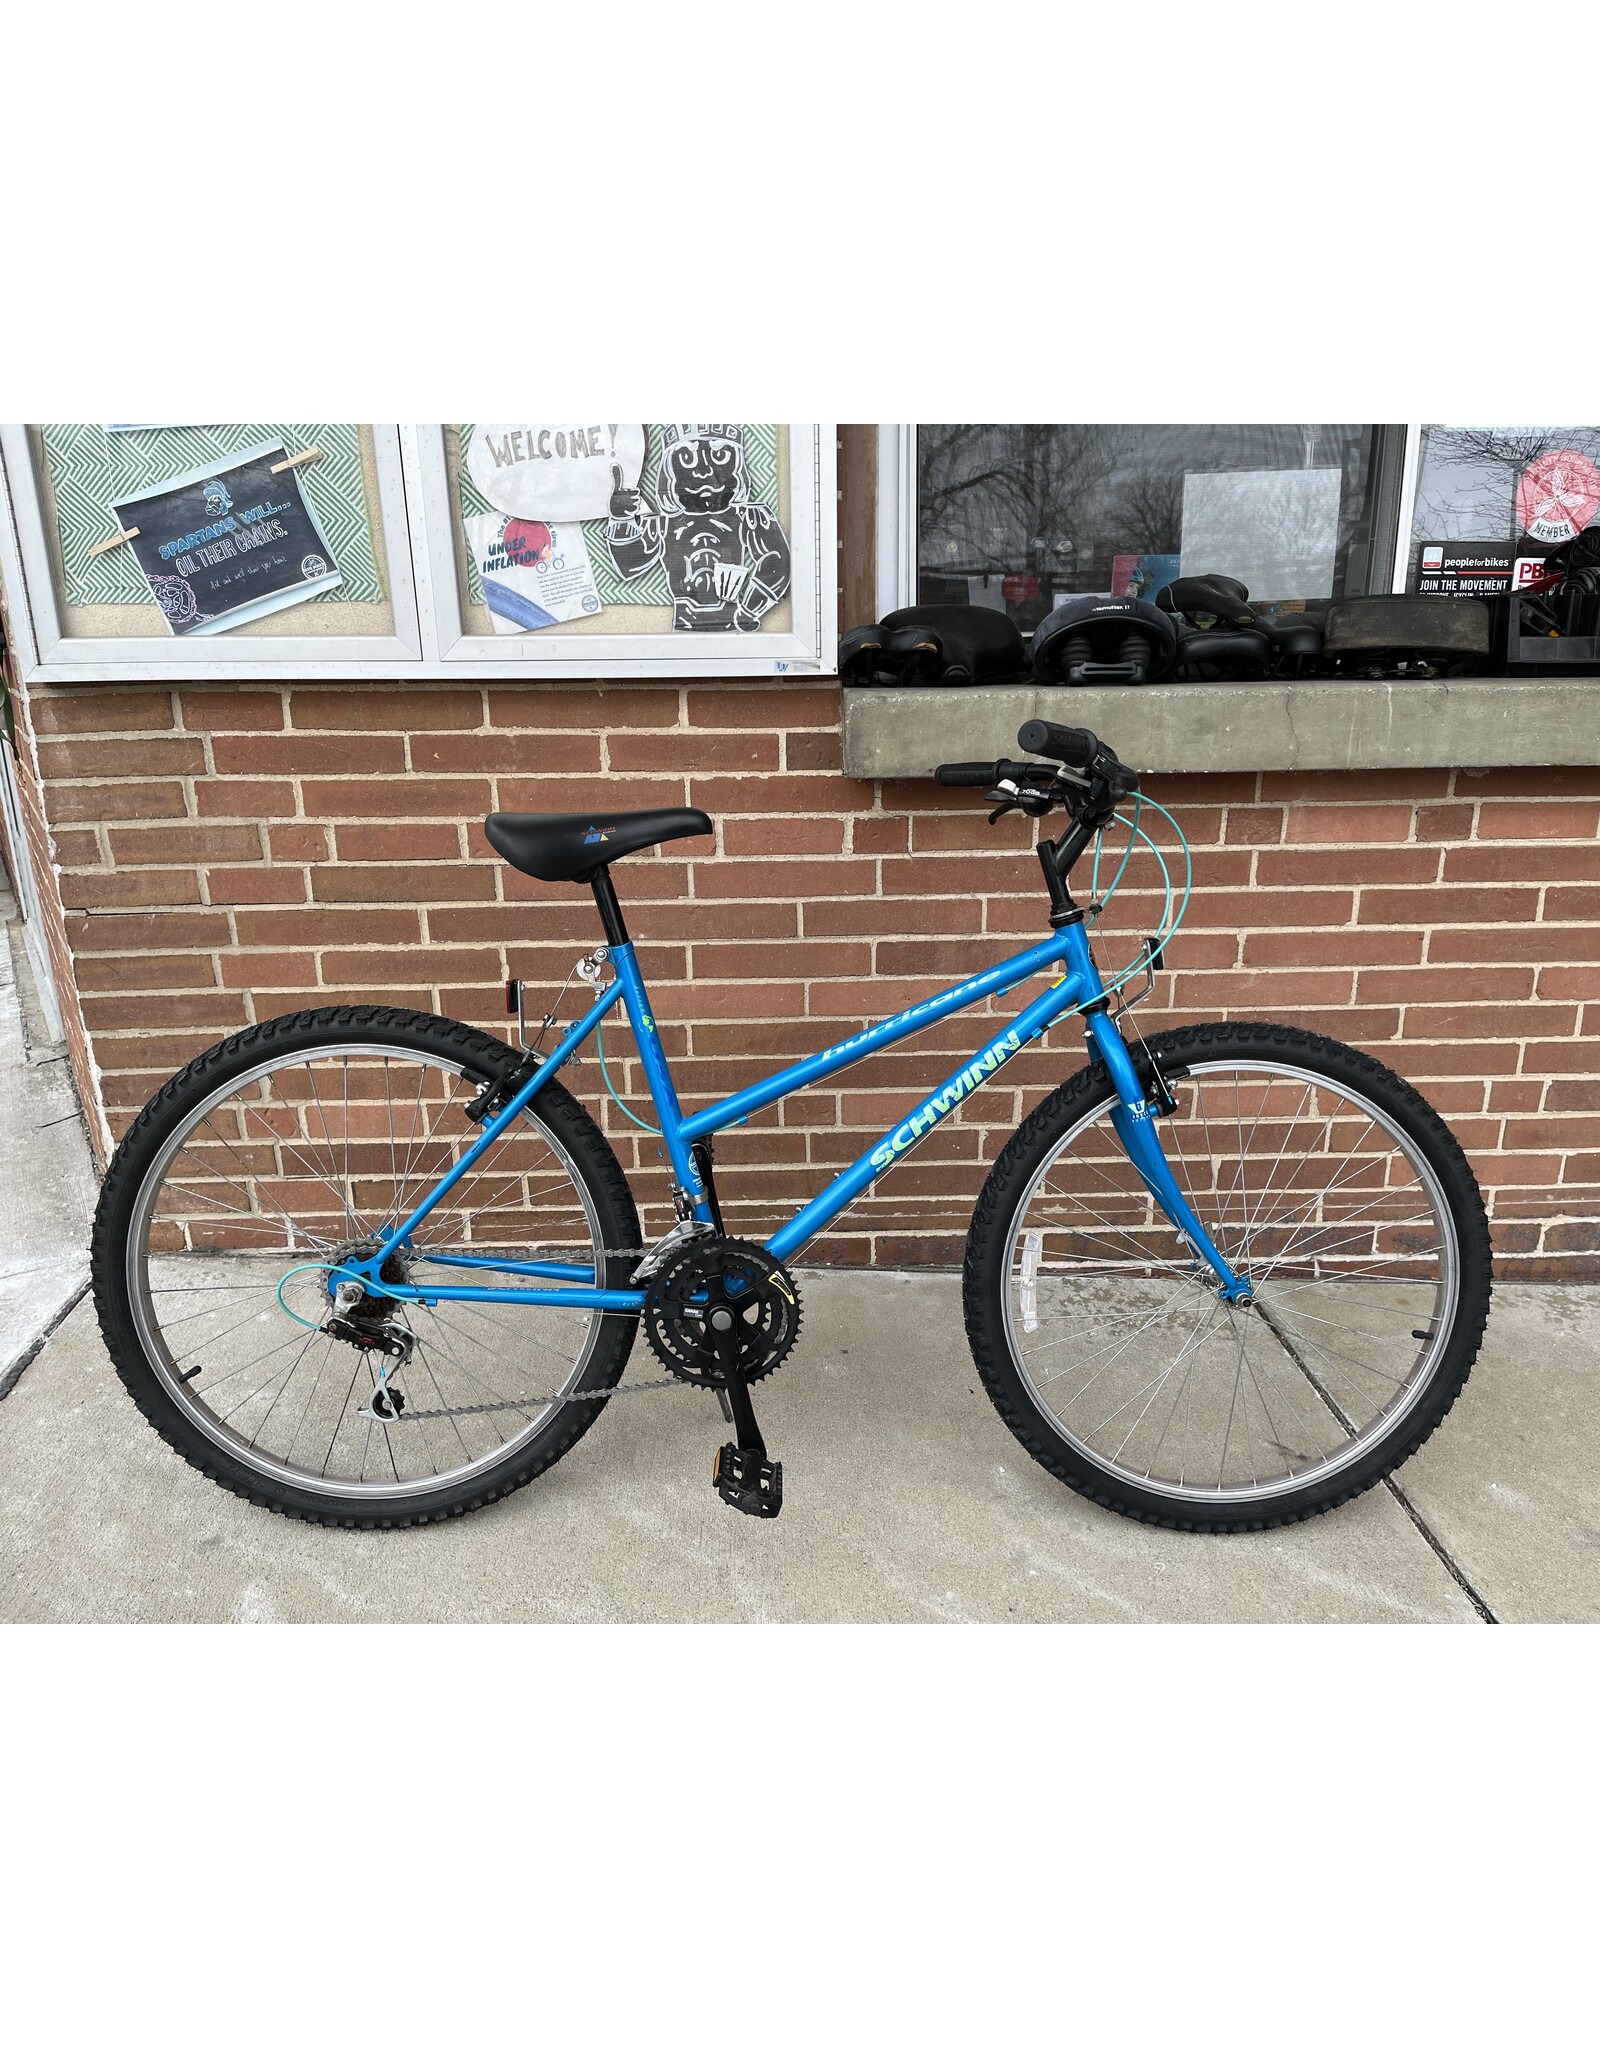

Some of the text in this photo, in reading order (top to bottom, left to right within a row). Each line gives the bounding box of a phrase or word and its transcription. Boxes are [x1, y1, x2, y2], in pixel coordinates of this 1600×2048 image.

[485, 424, 619, 468] WELCOME!
[158, 516, 237, 560] SPARTANS
[488, 536, 527, 557] UNDER
[1533, 522, 1571, 538] MEMBER
[175, 518, 289, 578] OIL THEIR CHAINS.
[483, 548, 540, 573] INFLATION
[1444, 557, 1509, 569] peopleforbikes
[1420, 579, 1439, 591] JOIN
[1441, 579, 1458, 591] THE
[1459, 579, 1508, 591] MOVEMENT
[821, 970, 1002, 1062] hurricane
[869, 1029, 1022, 1173] SCHWINN
